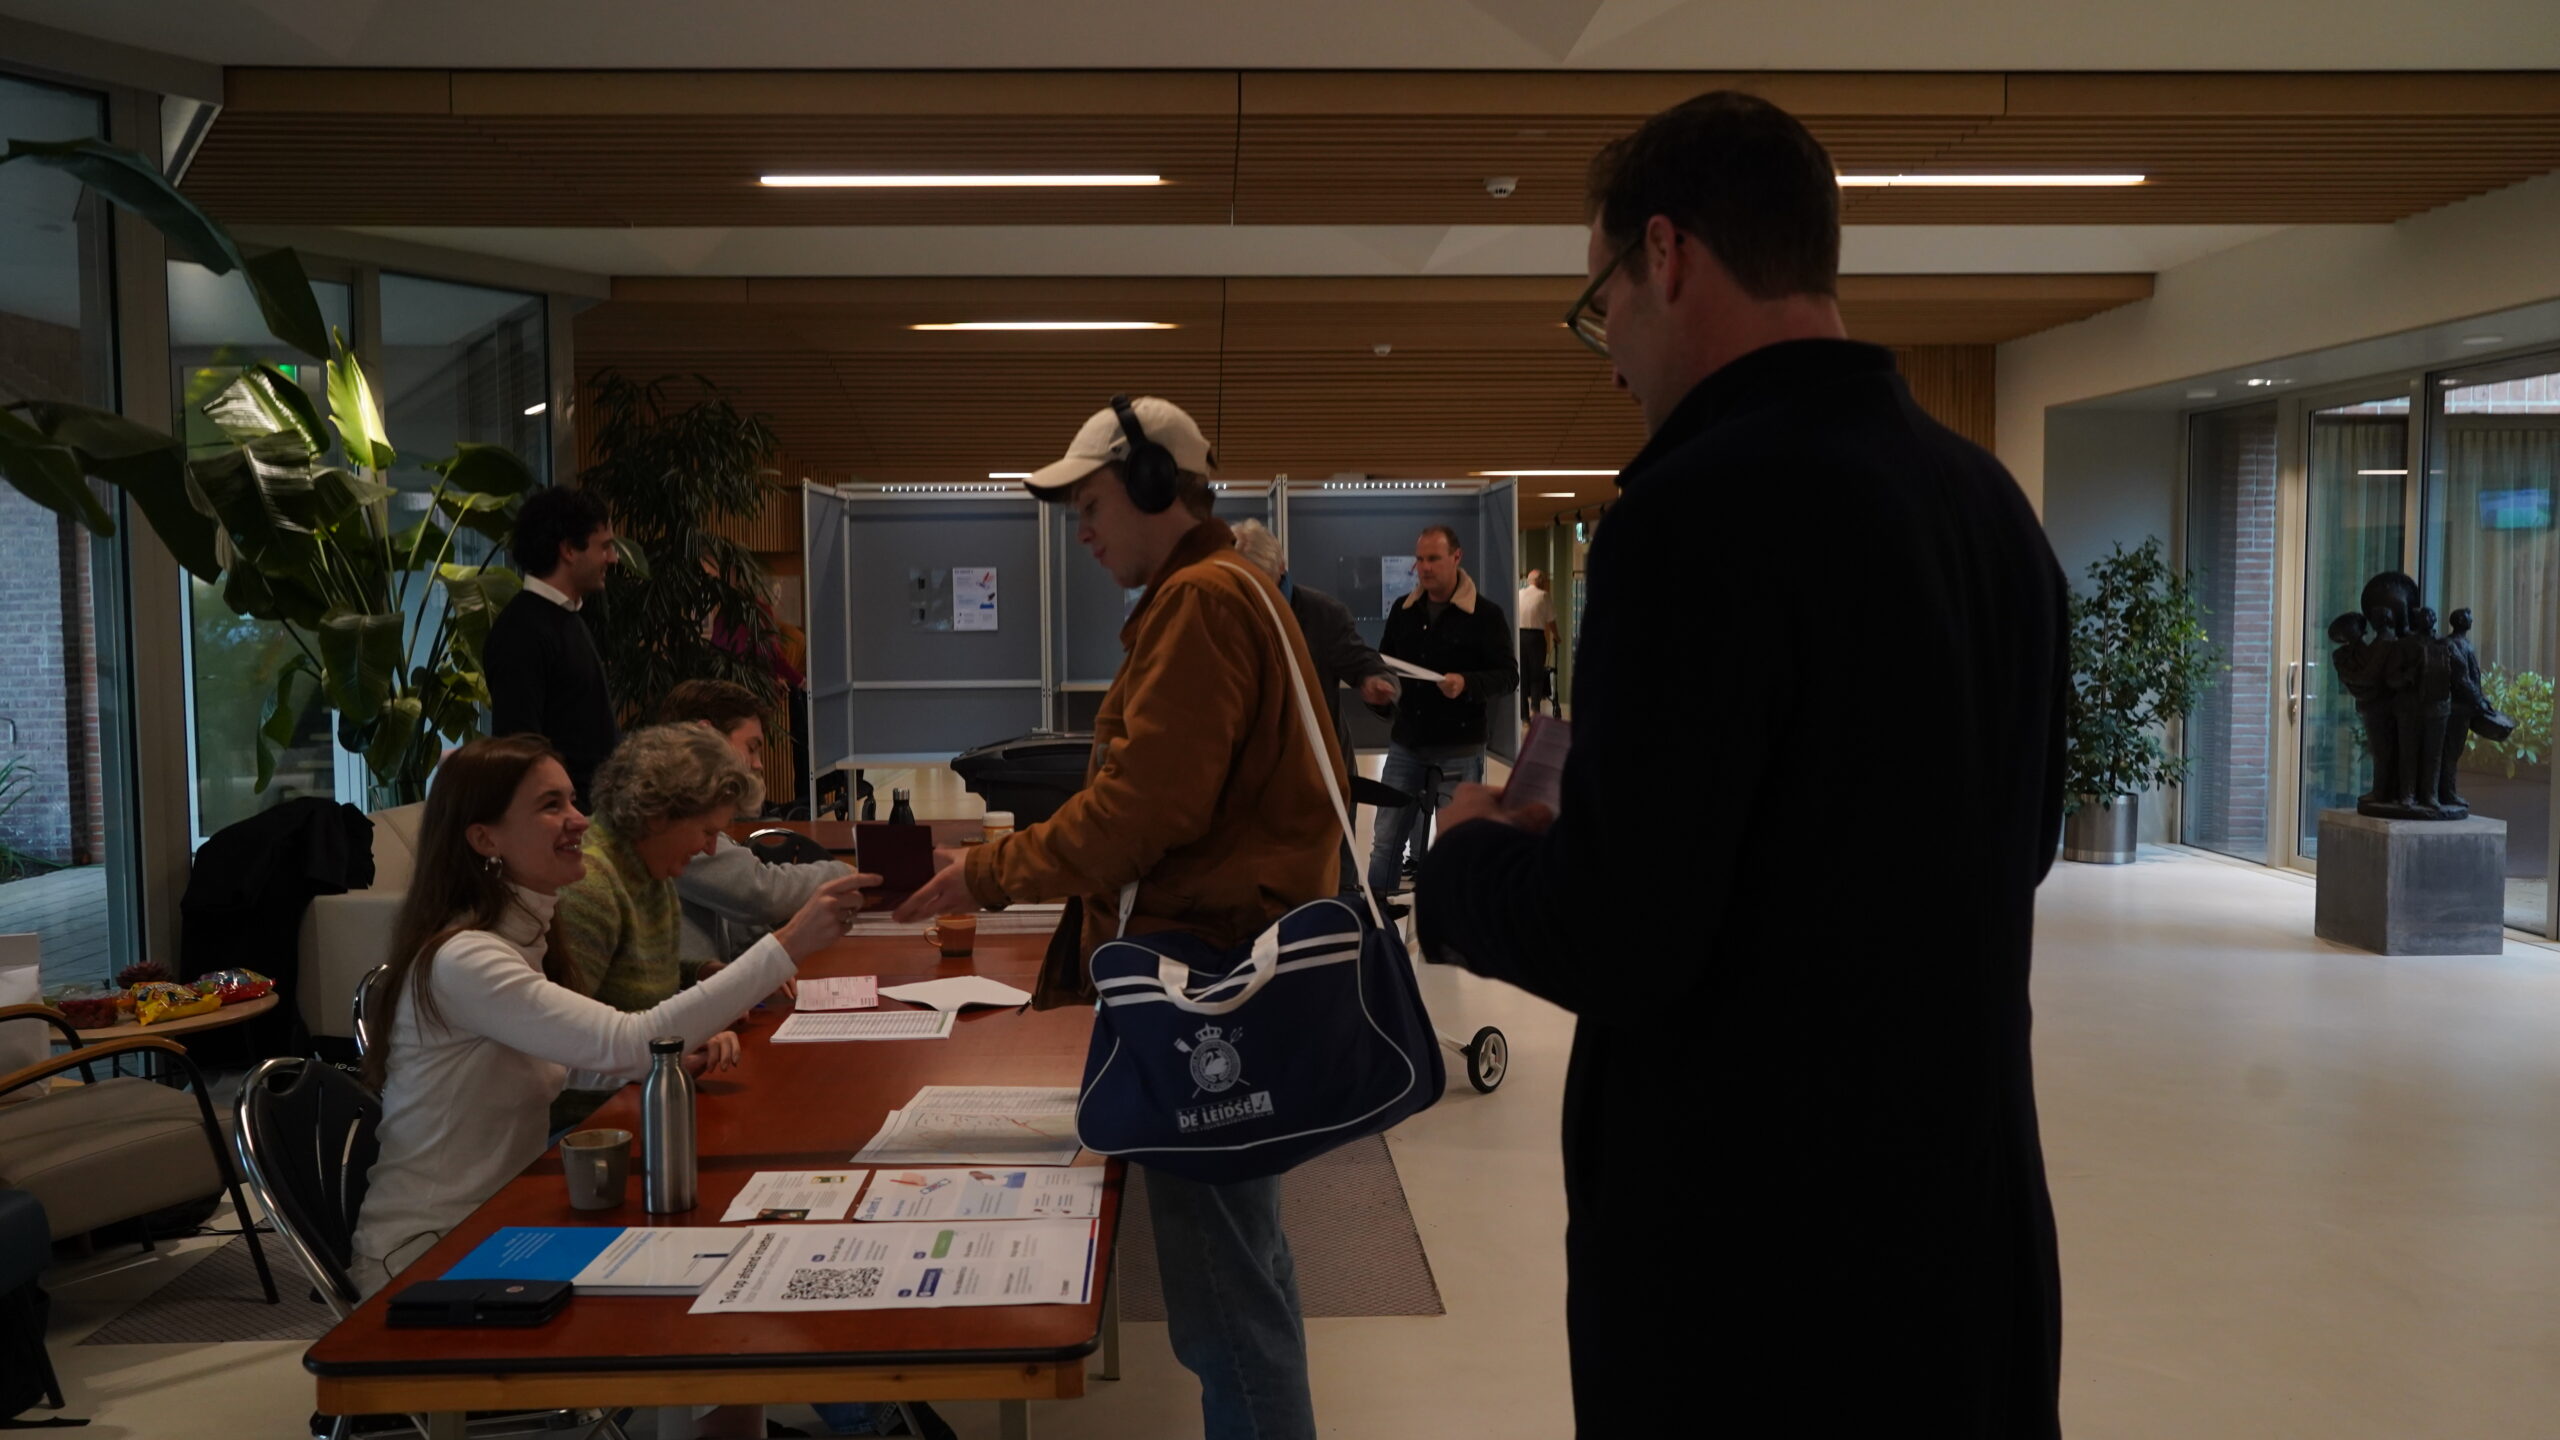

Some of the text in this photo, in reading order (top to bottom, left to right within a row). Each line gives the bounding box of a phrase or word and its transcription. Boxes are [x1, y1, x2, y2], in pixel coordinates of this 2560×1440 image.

[1179, 1113, 1198, 1128] DE
[1202, 1101, 1252, 1124] LEIDSE
[719, 1289, 739, 1304] Tolk
